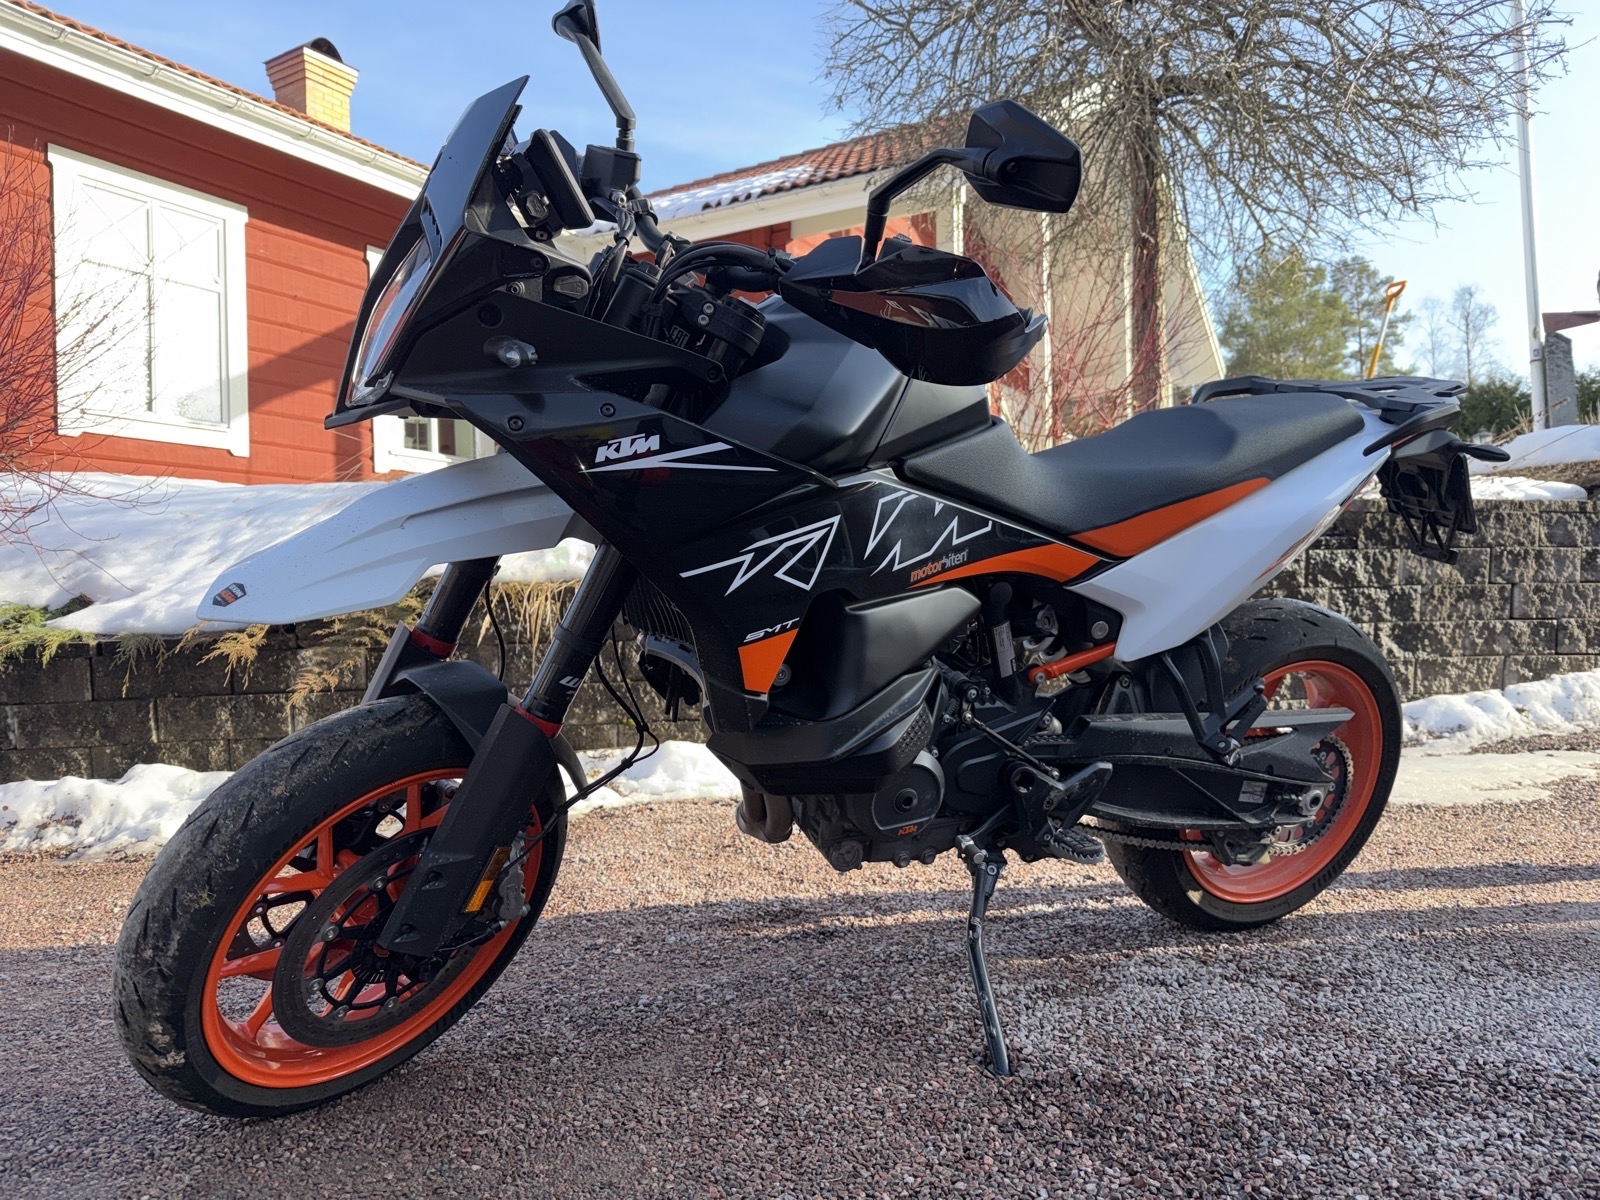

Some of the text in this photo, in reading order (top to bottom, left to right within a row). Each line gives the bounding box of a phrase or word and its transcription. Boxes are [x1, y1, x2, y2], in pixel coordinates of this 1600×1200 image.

[595, 433, 660, 463] KTM
[910, 549, 967, 582] motorbiten
[743, 617, 800, 643] SMT
[897, 825, 918, 836] KTM
